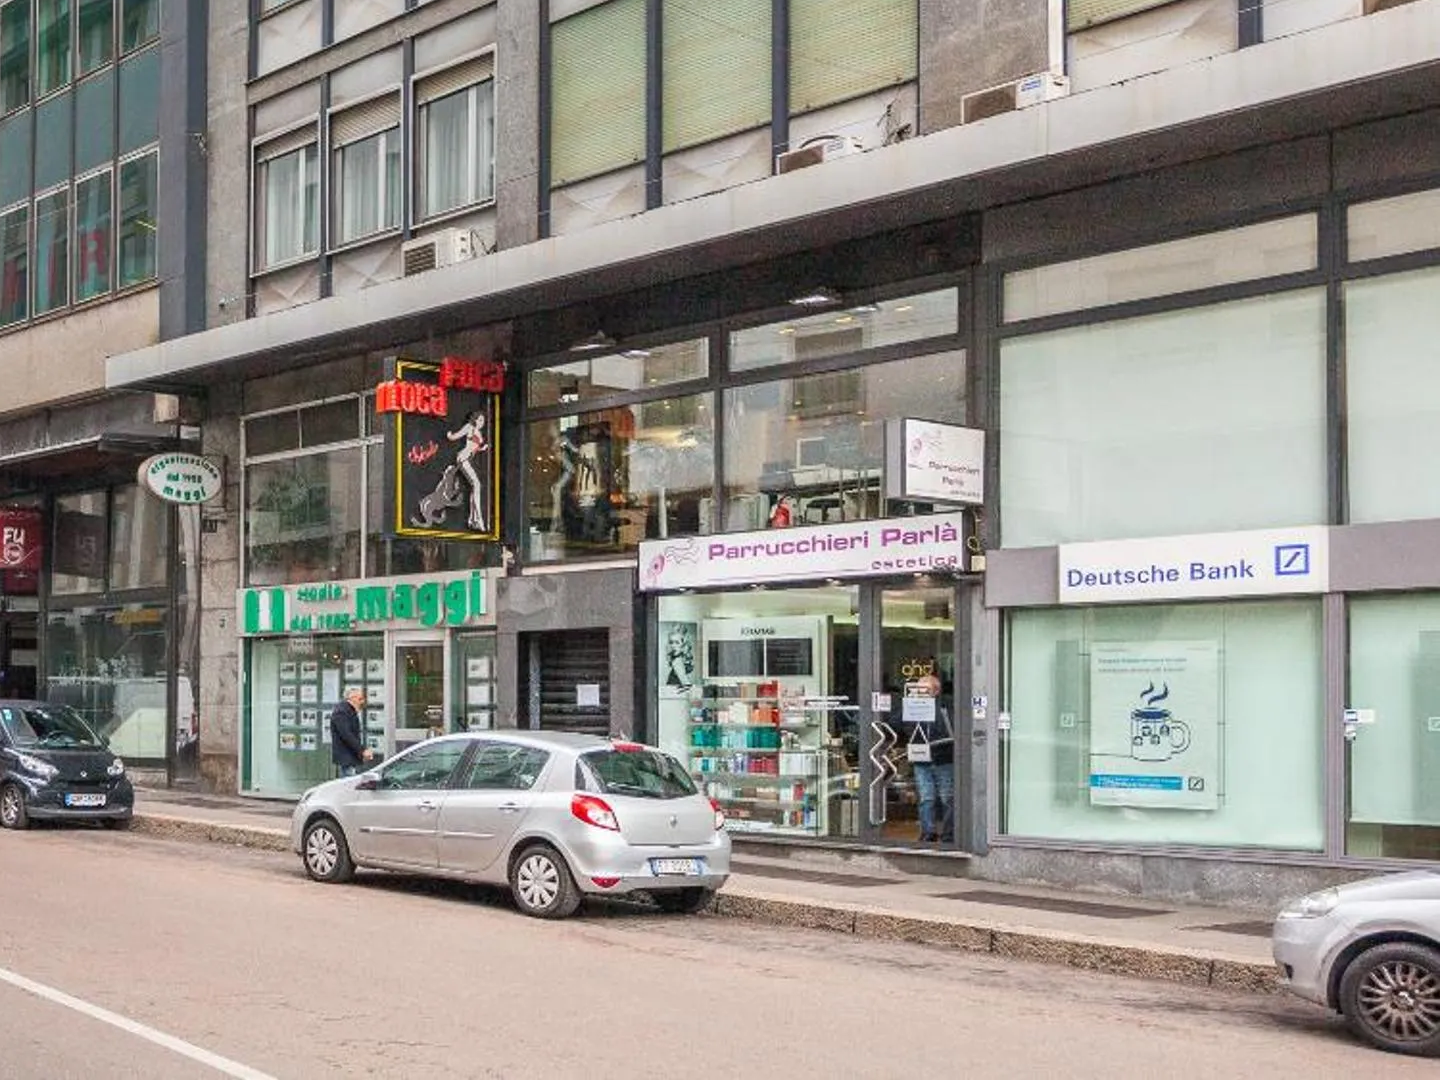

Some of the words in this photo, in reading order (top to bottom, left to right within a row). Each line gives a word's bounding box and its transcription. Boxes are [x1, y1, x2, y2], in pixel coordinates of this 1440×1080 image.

[709, 531, 869, 560] Parrucchieri
[881, 522, 958, 546] Parlà
[872, 555, 958, 570] estetica
[1067, 565, 1180, 587] Deutsche
[1190, 559, 1255, 581] Bank
[355, 570, 481, 627] maggi
